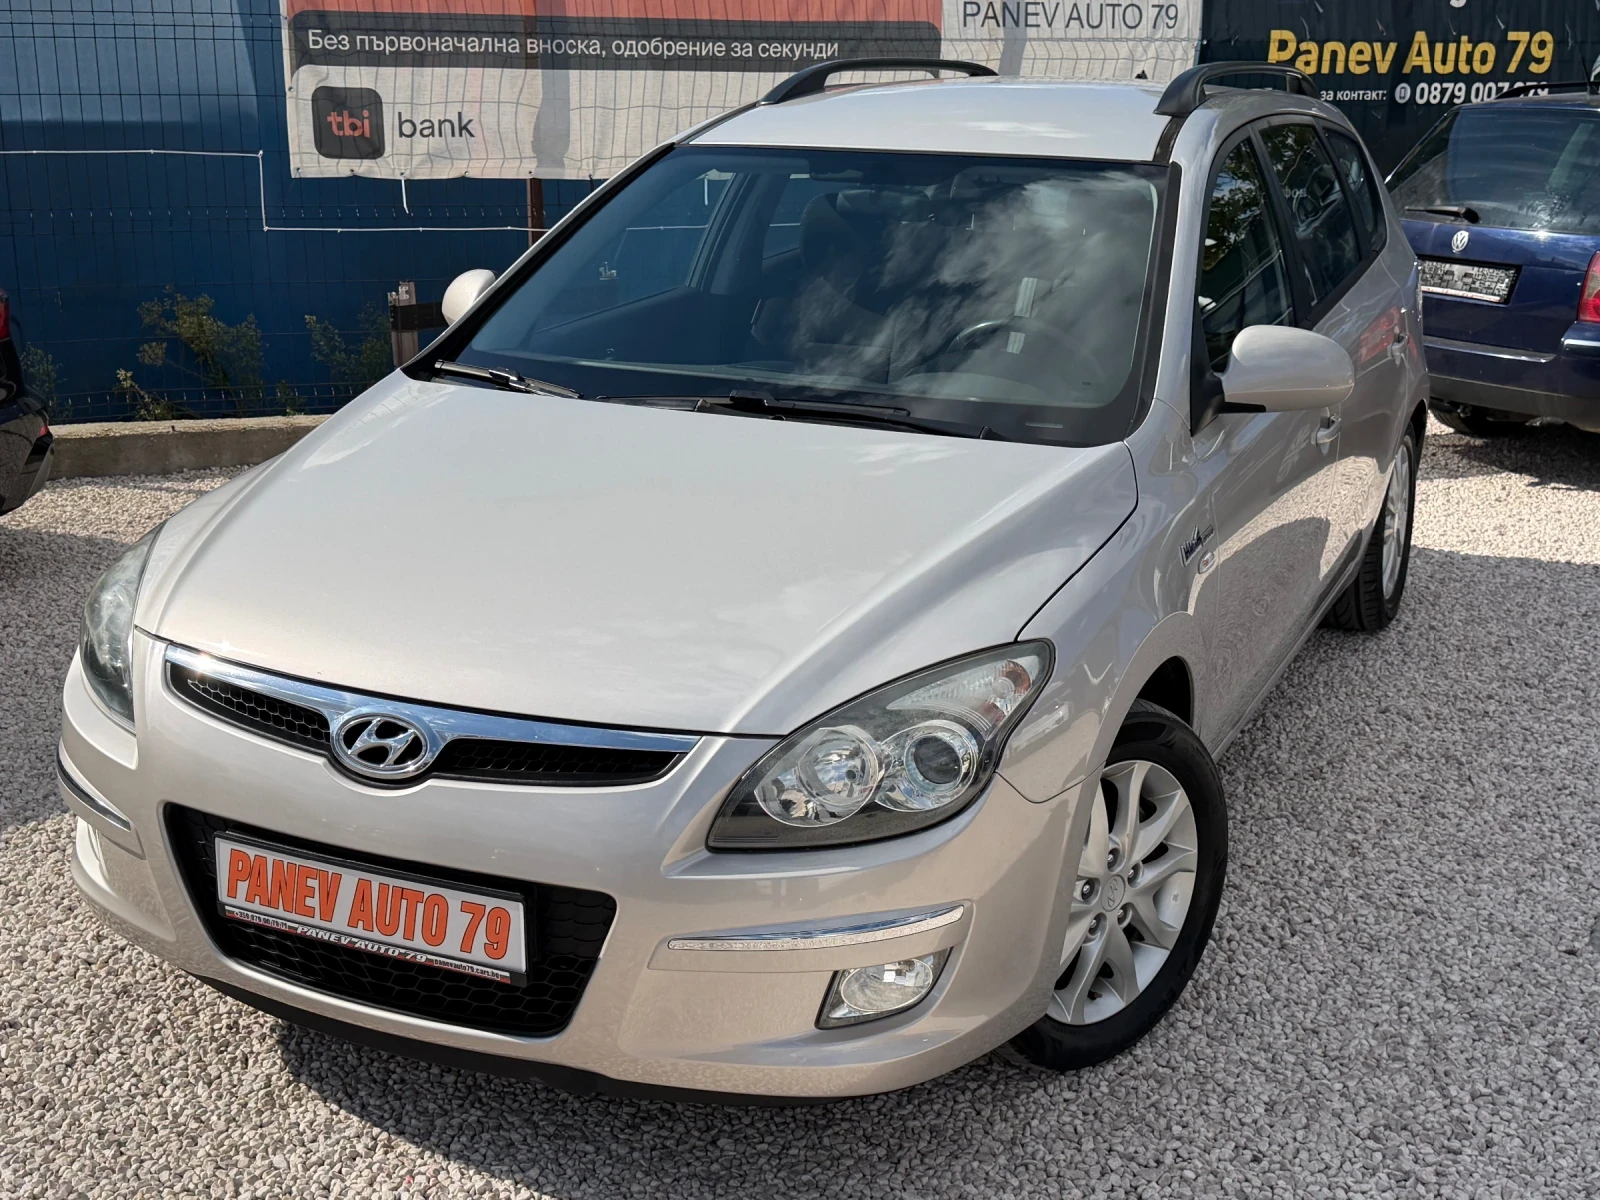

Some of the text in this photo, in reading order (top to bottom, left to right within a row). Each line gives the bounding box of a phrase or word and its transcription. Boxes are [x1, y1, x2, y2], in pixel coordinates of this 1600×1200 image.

[962, 1, 1179, 30] PANEV AUTO 79
[307, 29, 839, 61] Без първоначална вноска, одобрение за секунди
[1267, 29, 1555, 75] Panev Auto 79
[1319, 90, 1387, 101] за контакт:
[1415, 82, 1463, 105] 0879
[326, 109, 476, 138] tbi bank
[226, 848, 512, 960] PANEV AUTO 79
[296, 925, 428, 963] PANEV AUTO 79
